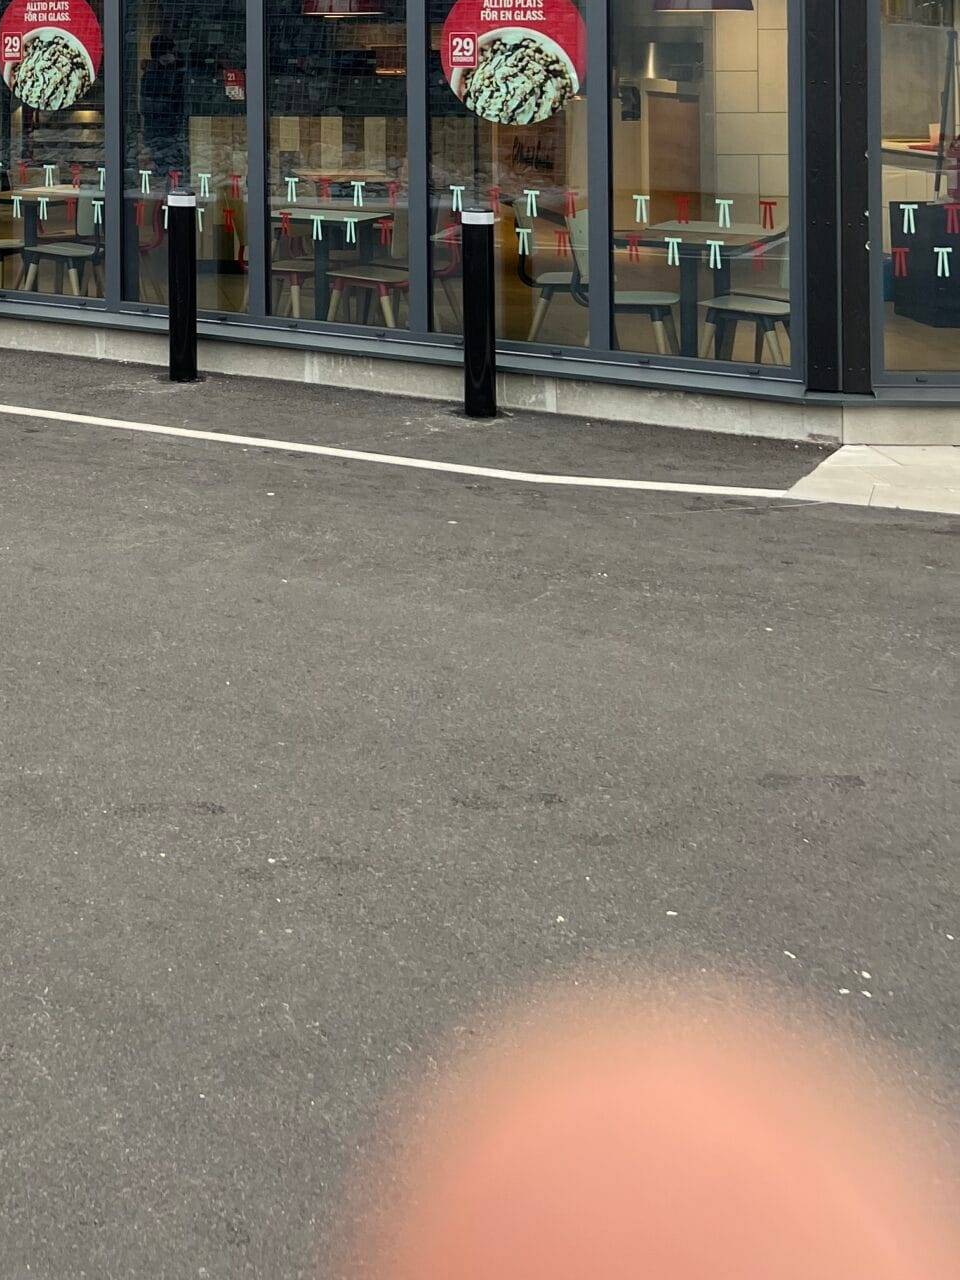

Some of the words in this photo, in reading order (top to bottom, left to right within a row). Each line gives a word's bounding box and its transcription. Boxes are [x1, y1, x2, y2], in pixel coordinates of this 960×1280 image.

[26, 1, 47, 11] ALLTID
[49, 1, 69, 11] PLATS
[38, 13, 47, 22] EN
[48, 12, 71, 22] GLASS.
[480, 8, 498, 21] FÖR
[500, 10, 512, 21] EN
[514, 10, 546, 21] GLASS.
[4, 36, 20, 52] 29
[452, 37, 474, 56] 29
